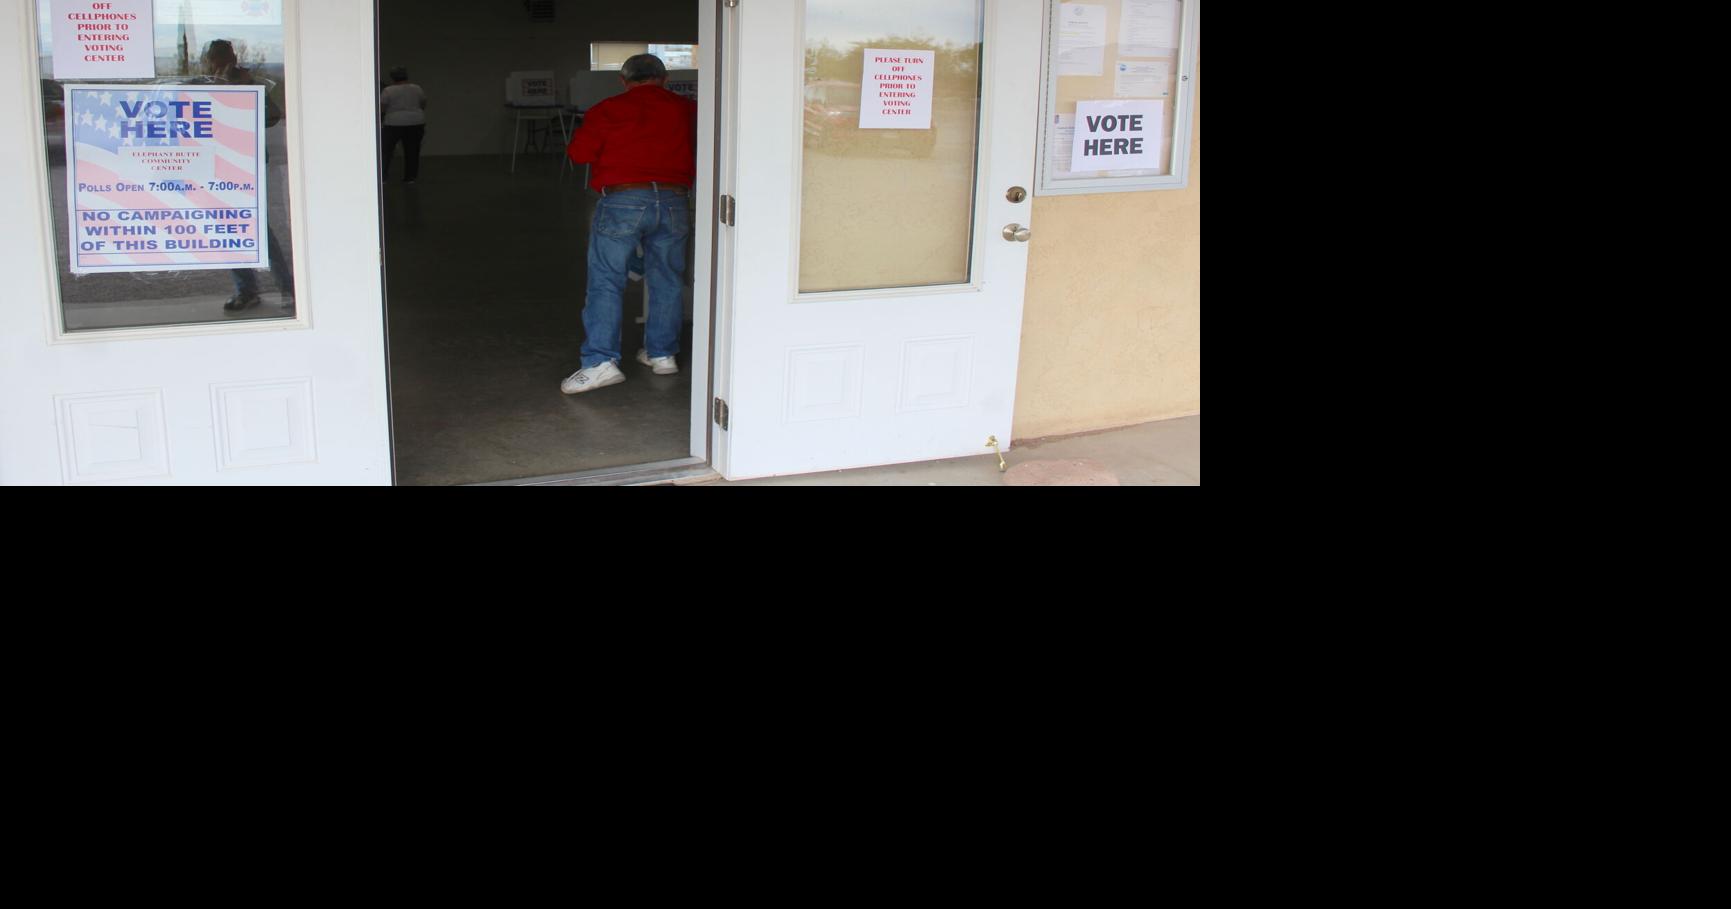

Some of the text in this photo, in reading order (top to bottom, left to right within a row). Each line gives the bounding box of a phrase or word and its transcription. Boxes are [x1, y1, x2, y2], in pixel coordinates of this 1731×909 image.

[92, 2, 112, 10] OFF
[68, 13, 137, 21] CELLPHONES
[77, 23, 129, 31] PRIOR TO
[77, 34, 130, 42] ENTERING
[84, 44, 124, 52] VOTING
[84, 54, 125, 62] CENTER
[119, 100, 213, 119] VOTE
[120, 121, 214, 138] HERE
[1086, 114, 1144, 133] VOTE
[1083, 137, 1144, 156] HERE
[83, 209, 252, 221] NO CAMPAIGNING
[85, 223, 250, 236] WITHIN 100 FEET
[80, 238, 255, 251] OF THIS BUILDING
